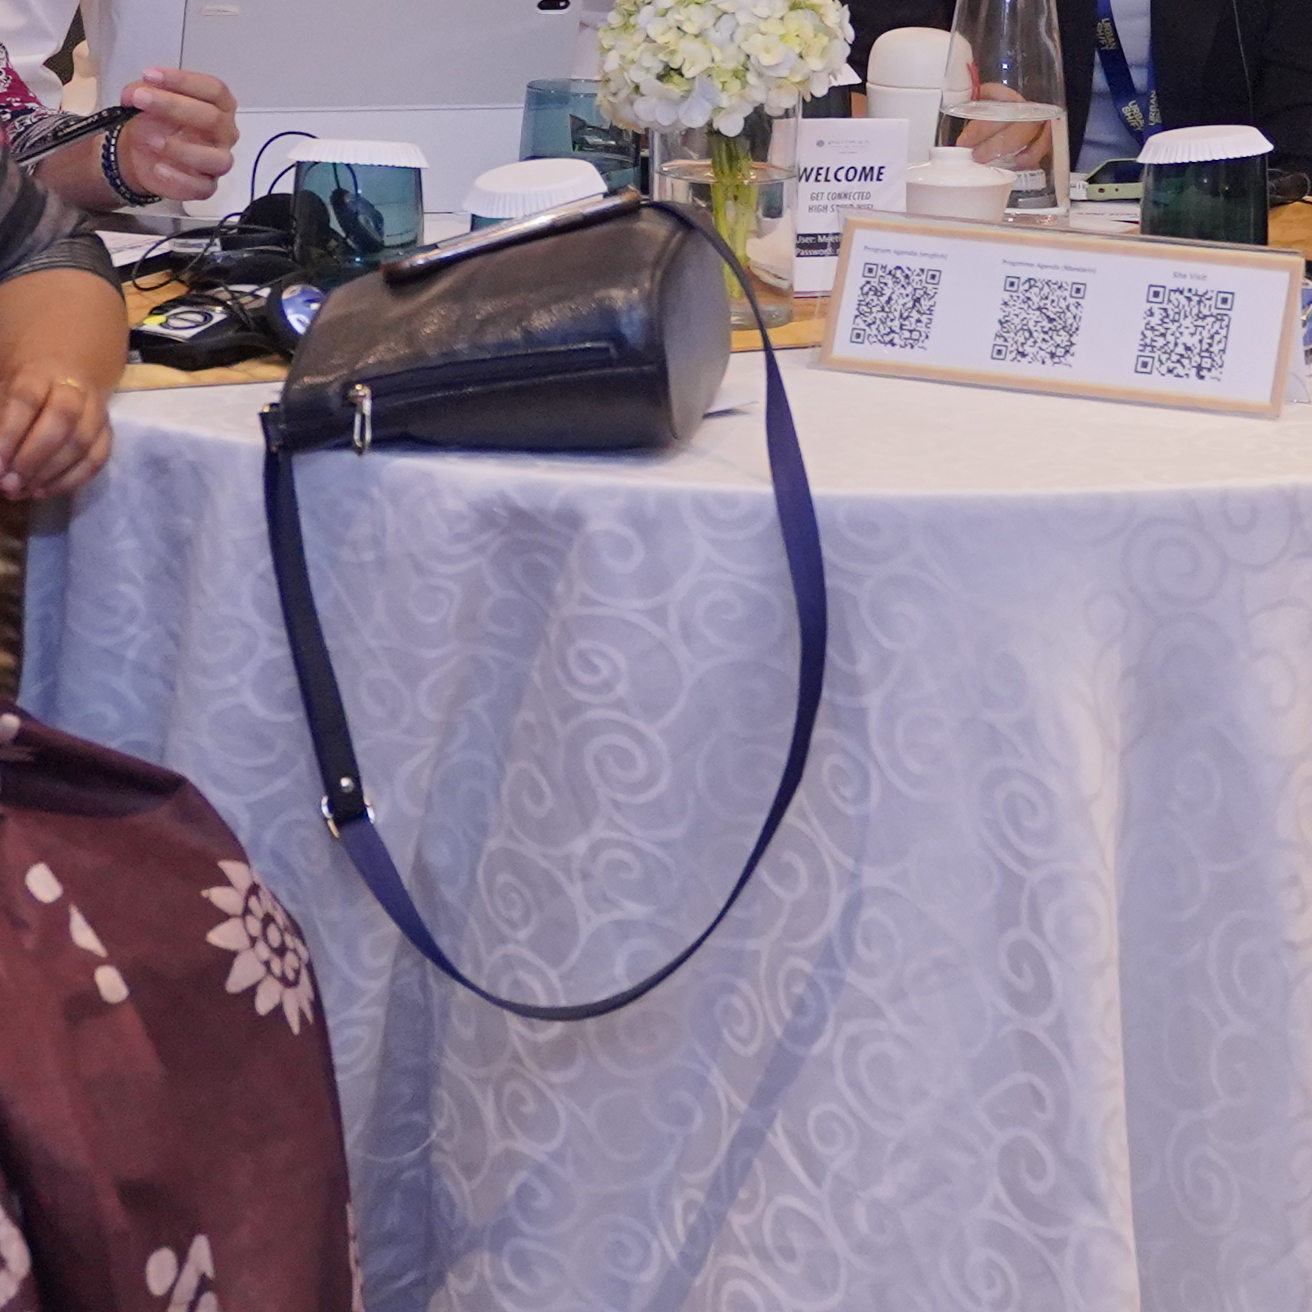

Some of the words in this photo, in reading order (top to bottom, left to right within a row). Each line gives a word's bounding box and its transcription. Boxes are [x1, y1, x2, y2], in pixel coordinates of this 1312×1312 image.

[798, 165, 886, 183] WELCOME
[810, 191, 825, 201] GET
[826, 191, 872, 201] CONNECTED
[808, 204, 828, 214] HIGH
[1172, 271, 1187, 280] Site
[1189, 272, 1207, 281] Visit
